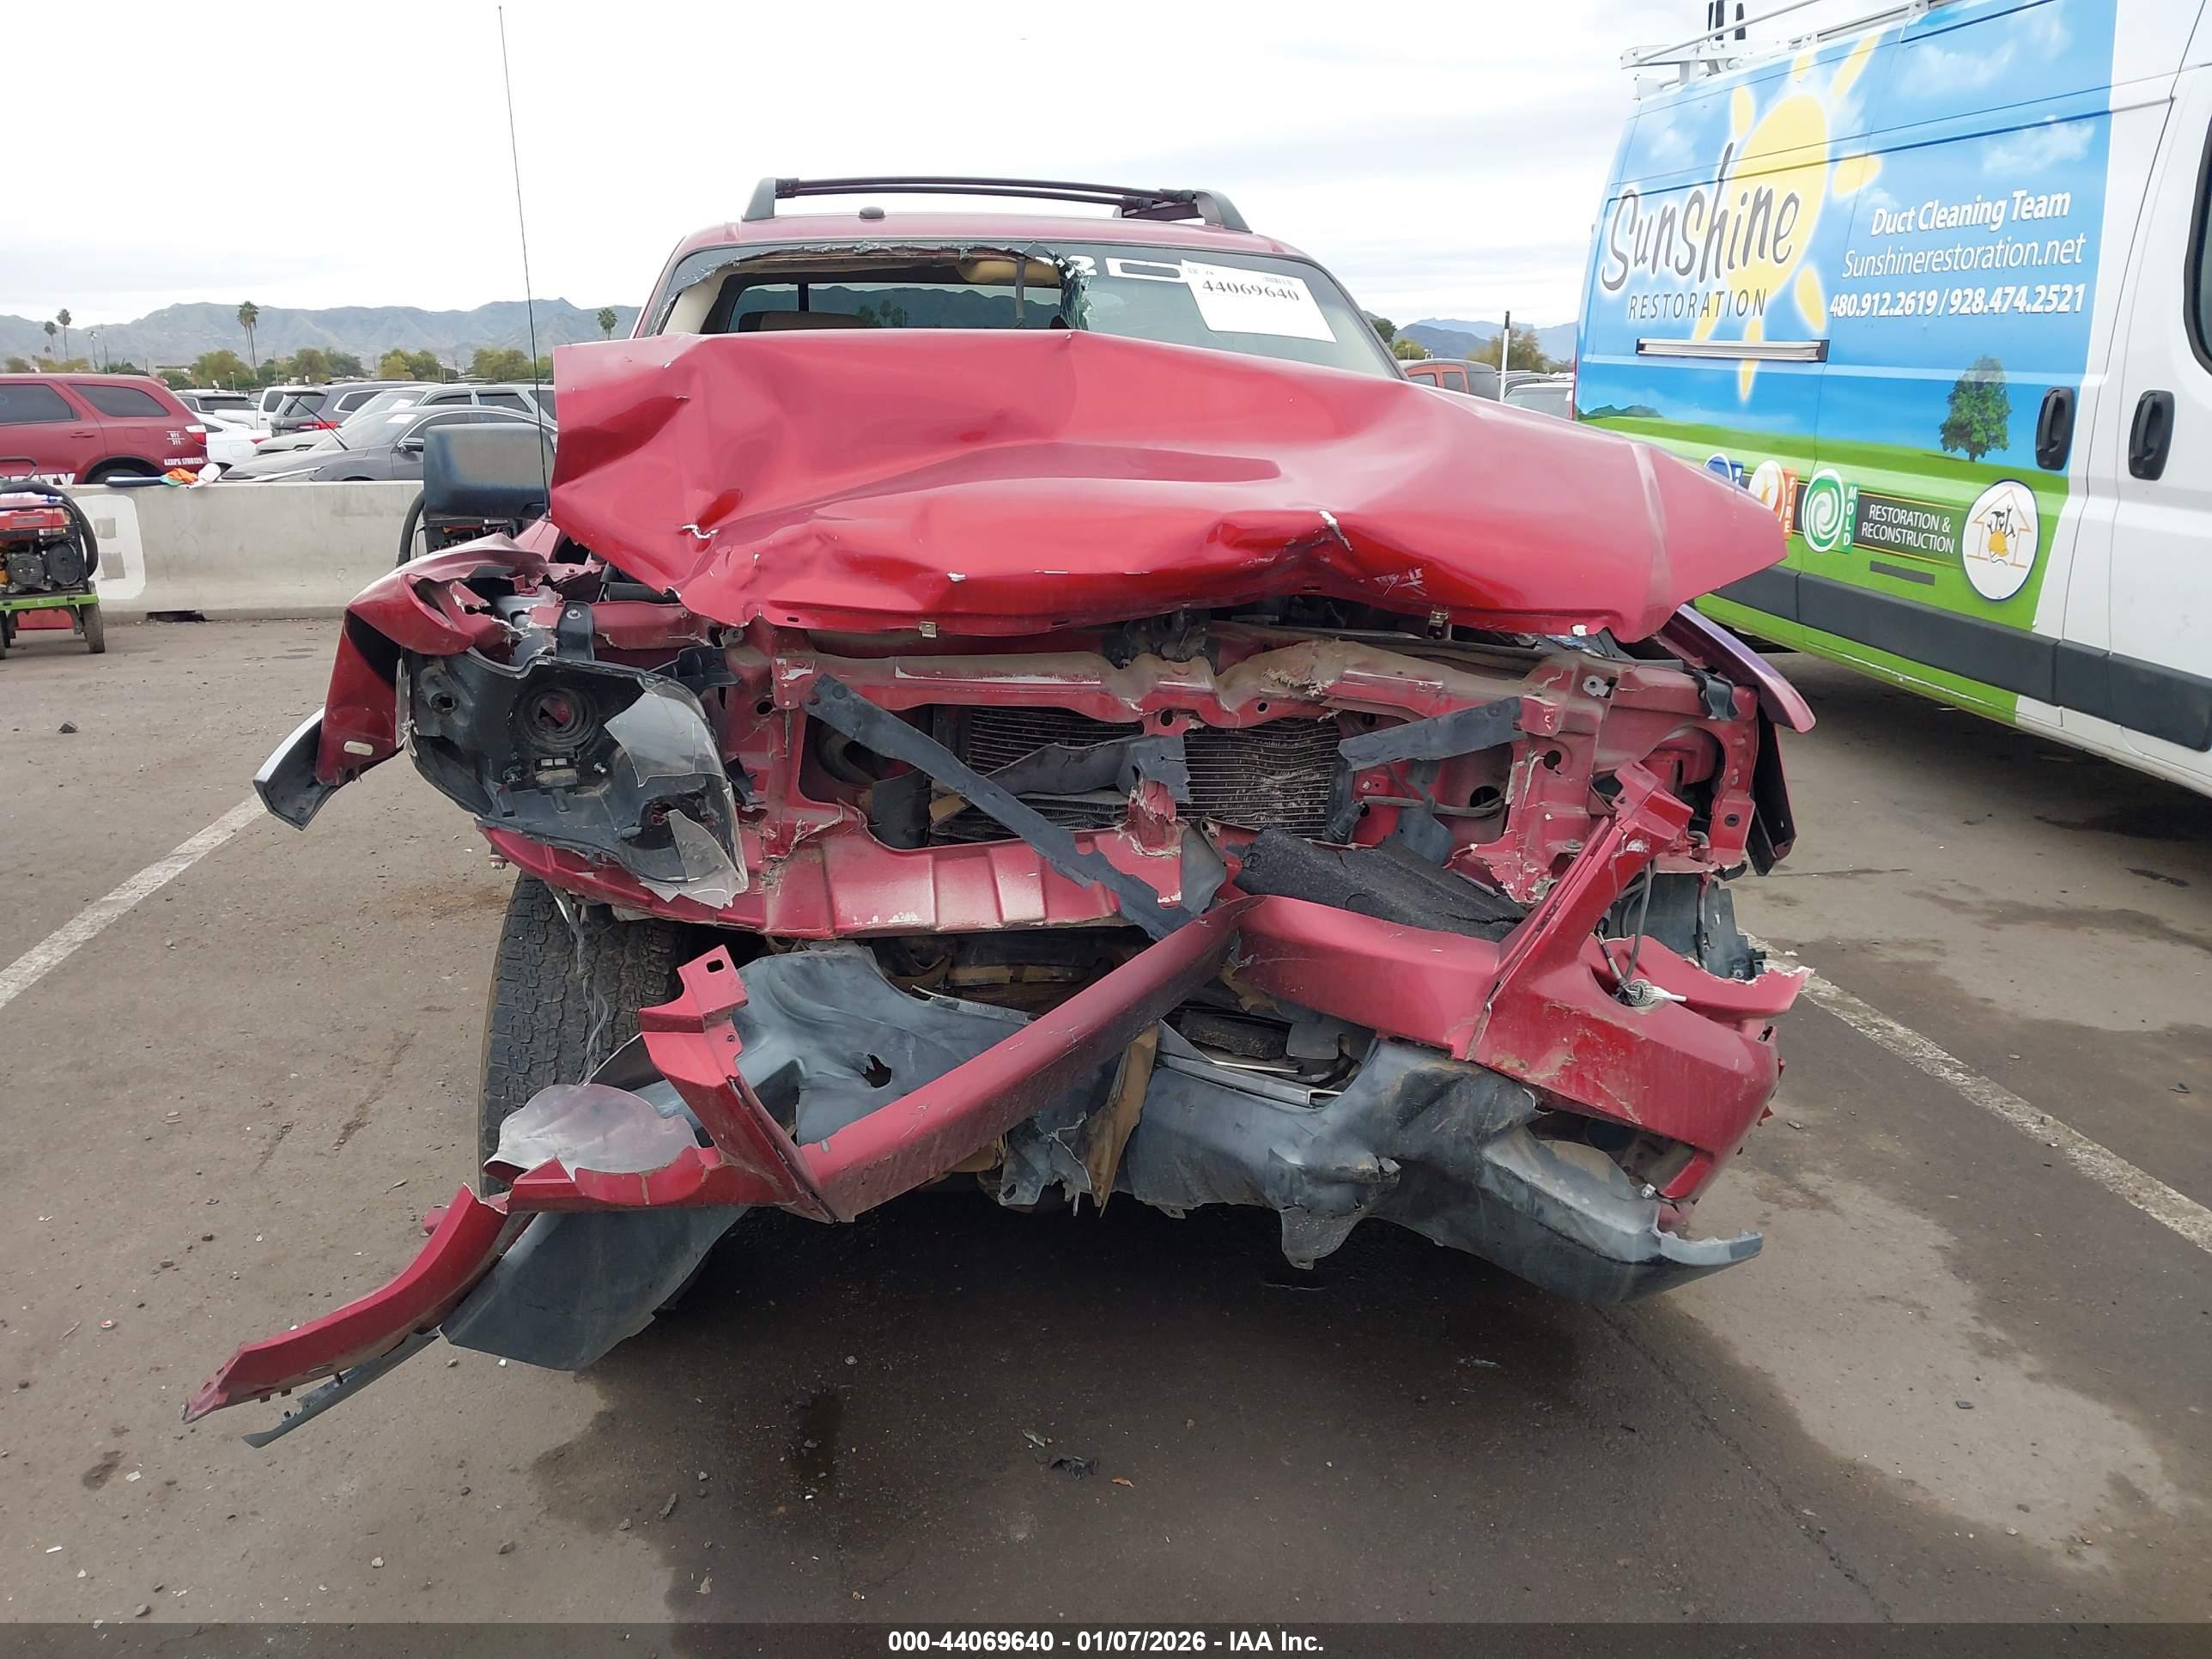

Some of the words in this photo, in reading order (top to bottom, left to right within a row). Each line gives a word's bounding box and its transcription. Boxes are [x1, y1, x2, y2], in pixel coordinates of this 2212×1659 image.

[1601, 142, 1800, 291] Sunshine
[1870, 207, 1916, 236] Duct
[1917, 194, 2008, 232] Cleaning
[2011, 189, 2071, 221] Team
[1842, 232, 2086, 279] Sunshinerestoration.net
[1202, 280, 1300, 301] 44069640
[1628, 289, 1767, 319] RESTORATION
[1829, 289, 1938, 318] 480.912.2619
[1949, 283, 2086, 315] 928.474.2521
[1784, 477, 1796, 533] FIRE
[1843, 486, 1857, 546] MOLD
[1869, 504, 1940, 532] RESTORATION
[1942, 516, 1952, 533] &
[1861, 521, 1955, 554] RECONSTRUCTION
